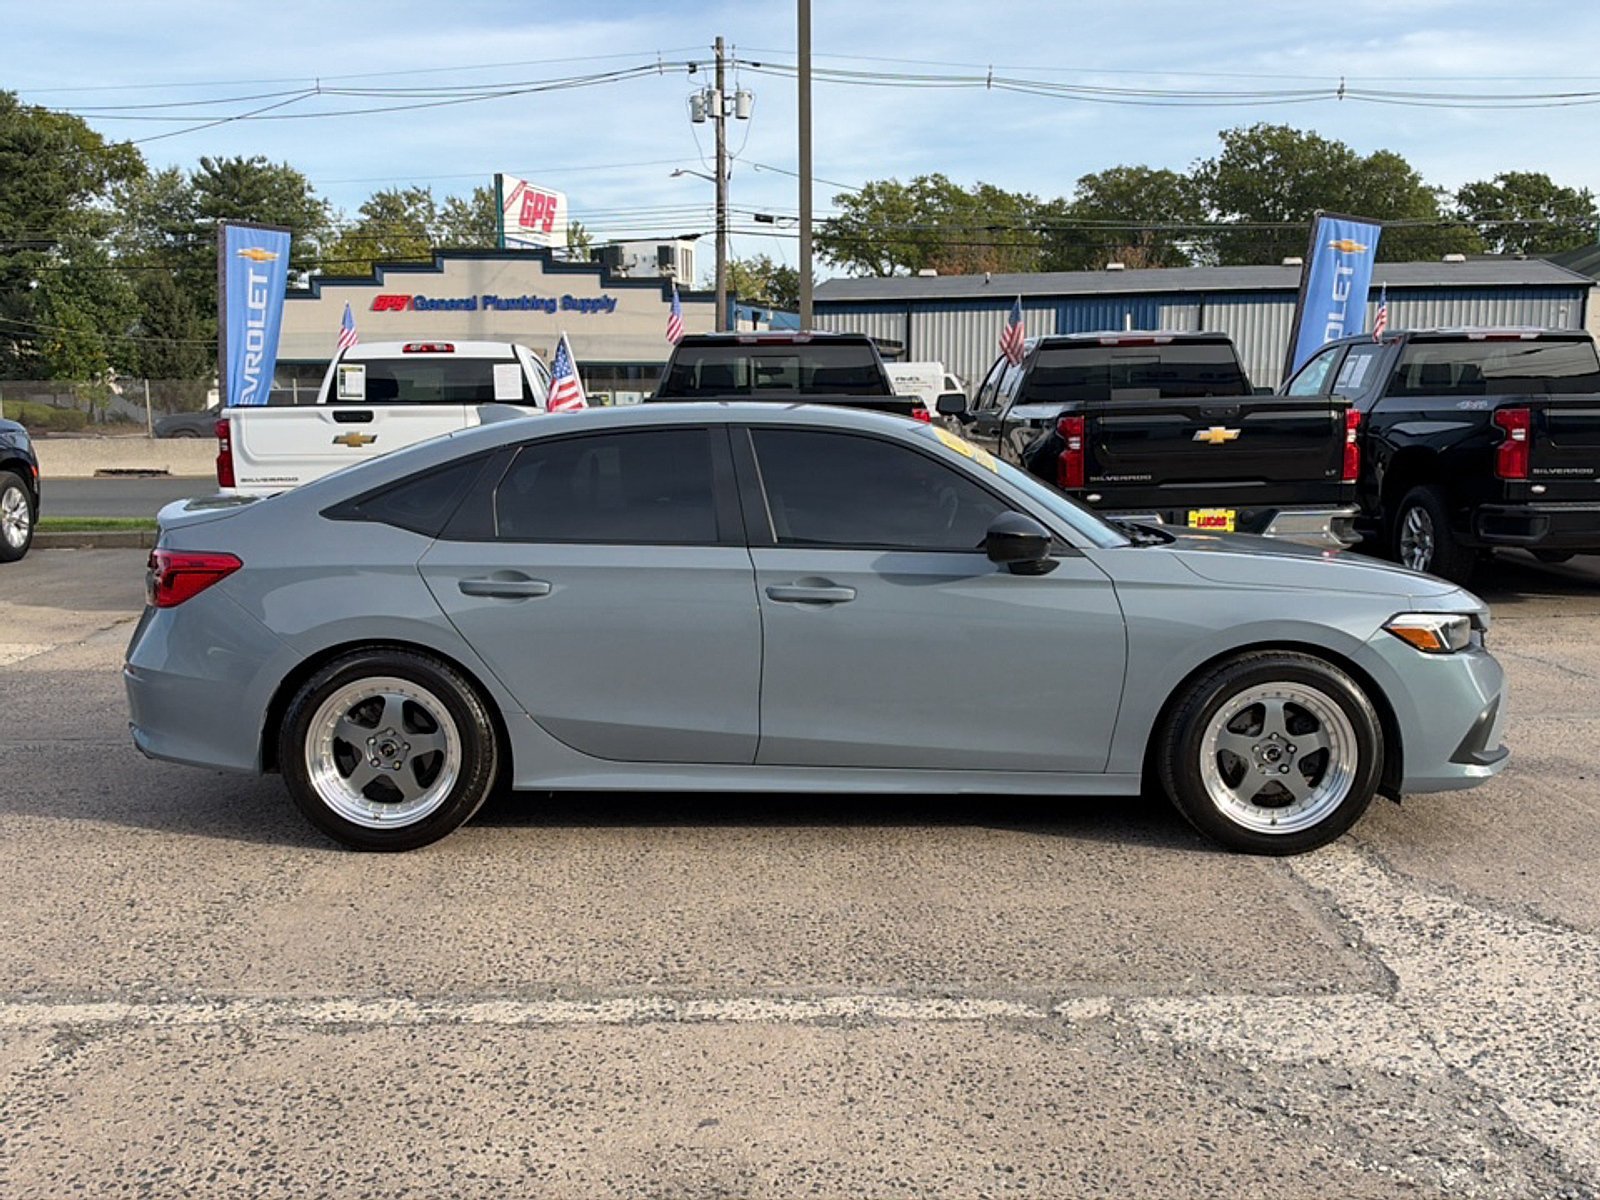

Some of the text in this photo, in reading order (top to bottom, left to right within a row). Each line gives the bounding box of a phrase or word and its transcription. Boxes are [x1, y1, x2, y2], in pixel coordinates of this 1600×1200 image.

[519, 189, 557, 233] GPS
[369, 294, 618, 314] GPS General Plumbing Supply
[1196, 516, 1228, 528] LUCAS
